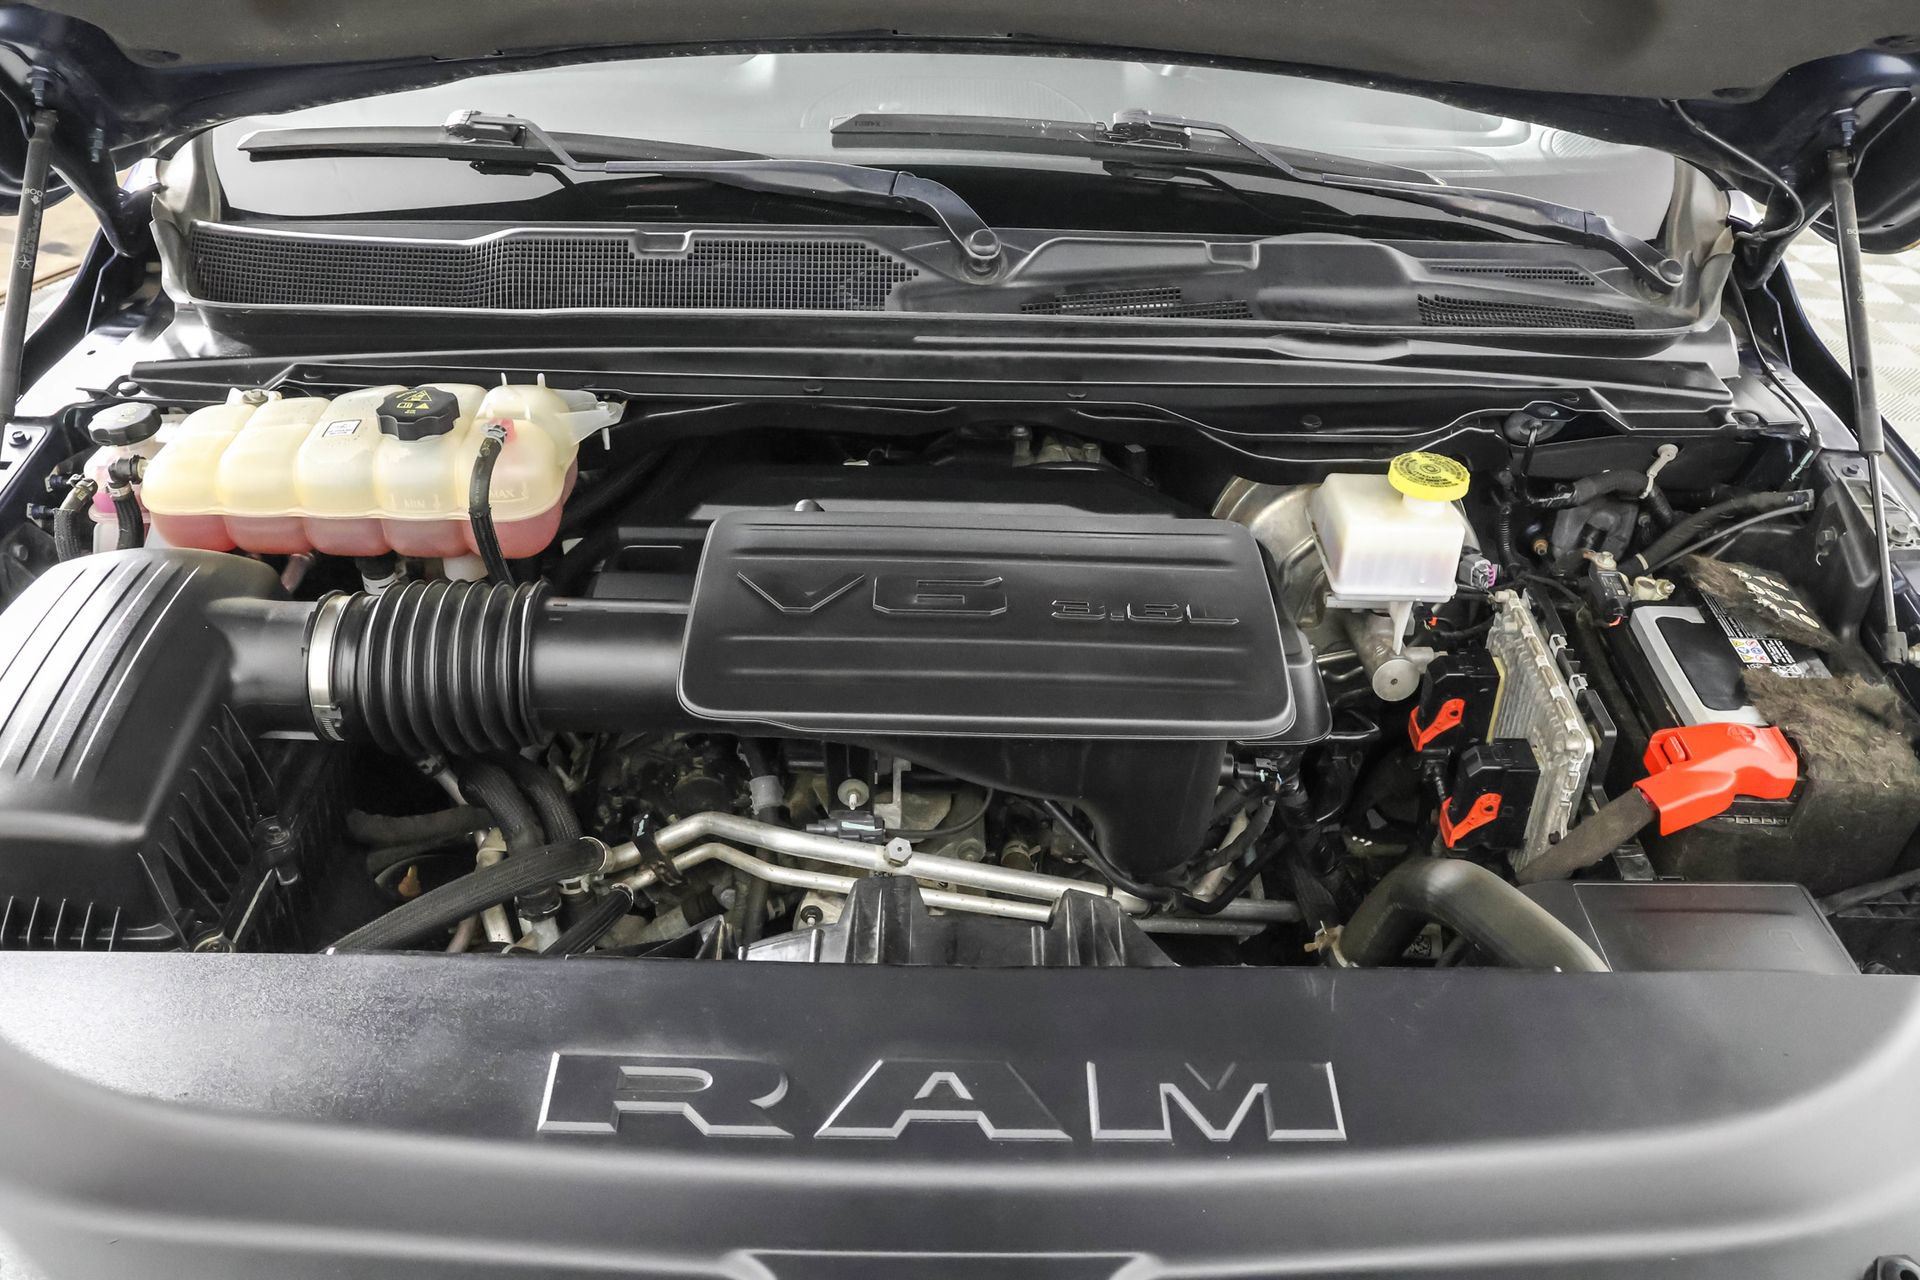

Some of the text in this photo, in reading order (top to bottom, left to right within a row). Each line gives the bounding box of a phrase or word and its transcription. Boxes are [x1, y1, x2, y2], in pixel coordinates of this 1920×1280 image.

[737, 571, 1240, 625] V6 3.6L
[537, 1050, 1346, 1141] RAM
